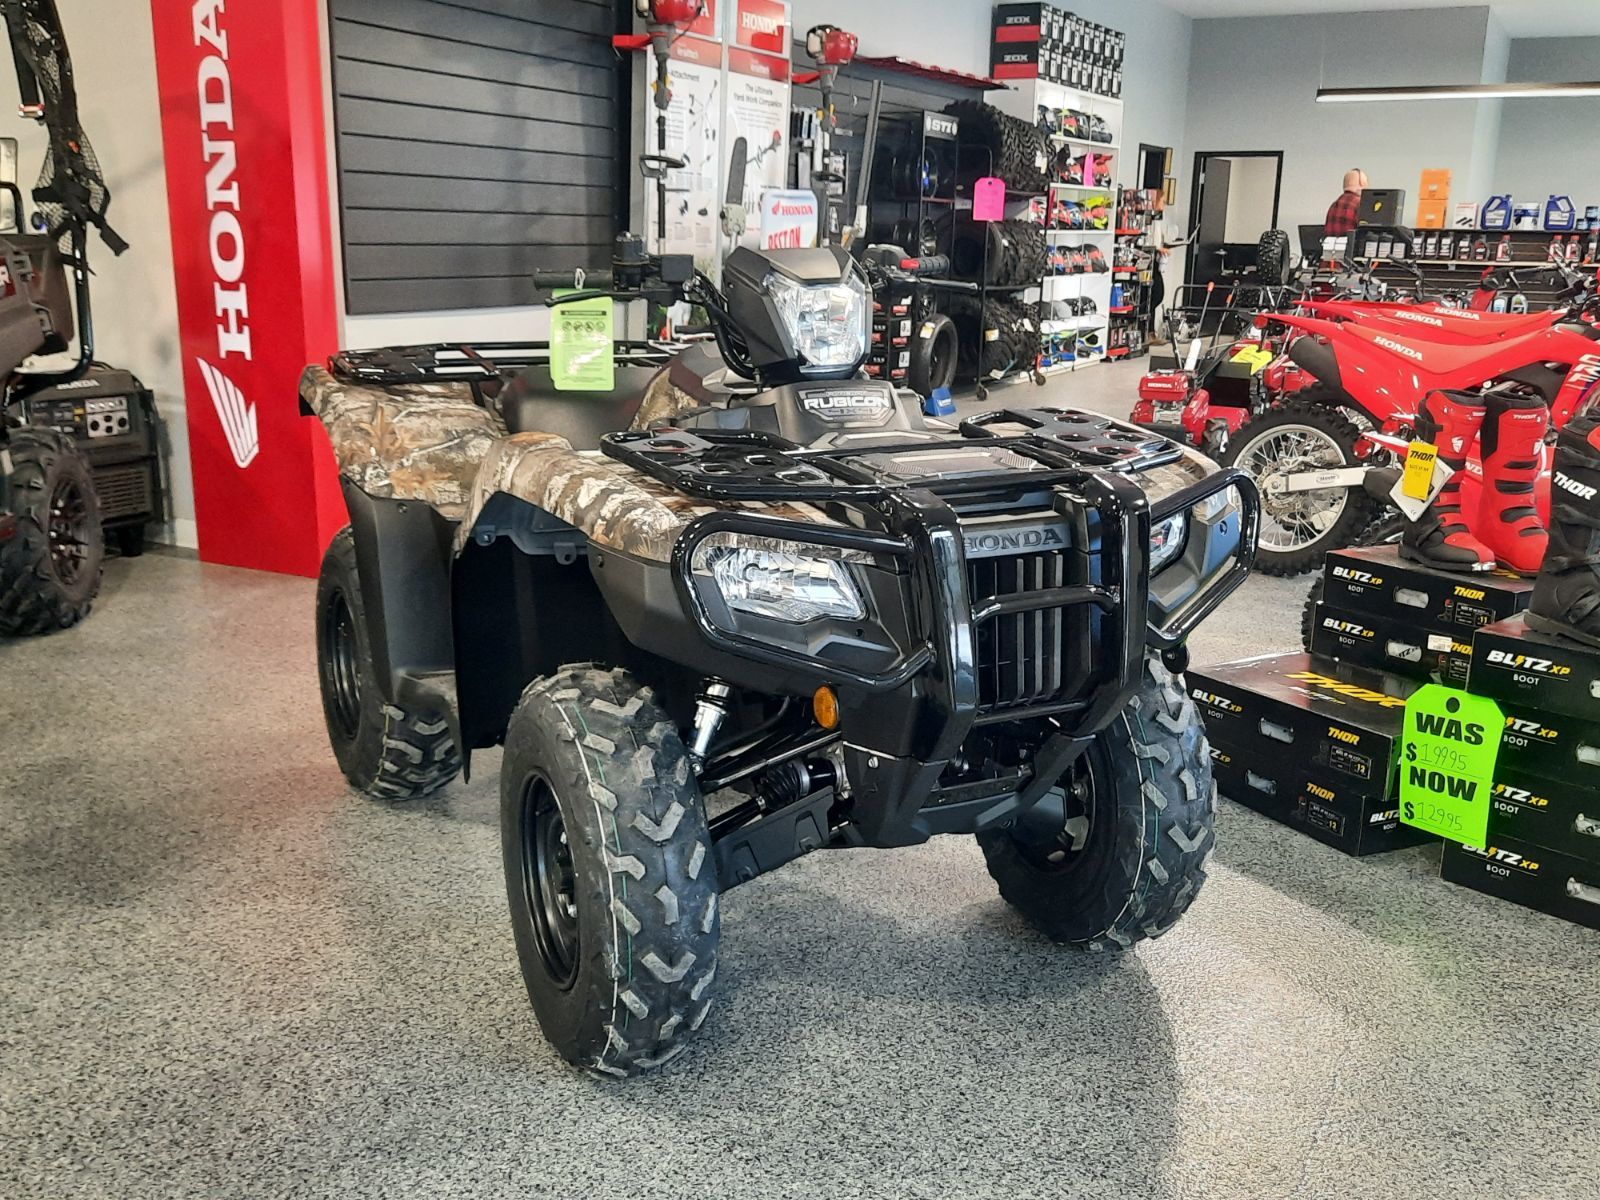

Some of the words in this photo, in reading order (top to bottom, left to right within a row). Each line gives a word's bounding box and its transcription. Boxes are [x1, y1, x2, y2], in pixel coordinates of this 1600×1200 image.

[742, 12, 779, 36] HONDA
[1006, 16, 1030, 24] ZOX
[1004, 54, 1028, 62] ZOX
[192, 0, 252, 360] HONDA
[782, 205, 813, 216] HONDA
[1395, 311, 1443, 327] HONDA
[1434, 306, 1480, 320] HONDA
[1374, 335, 1423, 361] HONDA
[804, 397, 890, 410] RUBICON
[1410, 450, 1434, 462] THOR
[1553, 471, 1598, 500] THOR
[1332, 565, 1372, 585] BLITZ
[1368, 576, 1383, 586] XP
[1348, 584, 1364, 594] BOOT
[1453, 586, 1485, 601] THOR
[1323, 617, 1364, 635] BLITZ
[1361, 629, 1375, 638] XP
[1339, 636, 1356, 646] BOOT
[1450, 641, 1472, 655] THO
[1486, 649, 1553, 672] BLITZ
[1549, 665, 1571, 675] XP
[1513, 673, 1540, 685] BOOT
[1191, 688, 1231, 709] BLITZ
[1229, 703, 1242, 713] XP
[1208, 709, 1224, 720] BOOT
[1328, 726, 1360, 745] THOR
[1415, 711, 1485, 746] WAS
[1537, 728, 1558, 738] XP
[1503, 735, 1529, 747] BOOT
[1409, 765, 1478, 802] NOW
[1306, 782, 1335, 802] THOR
[1494, 801, 1519, 815] BOOT
[1528, 796, 1549, 806] XP
[1486, 864, 1510, 877] BOOT
[1519, 860, 1540, 870] XP
